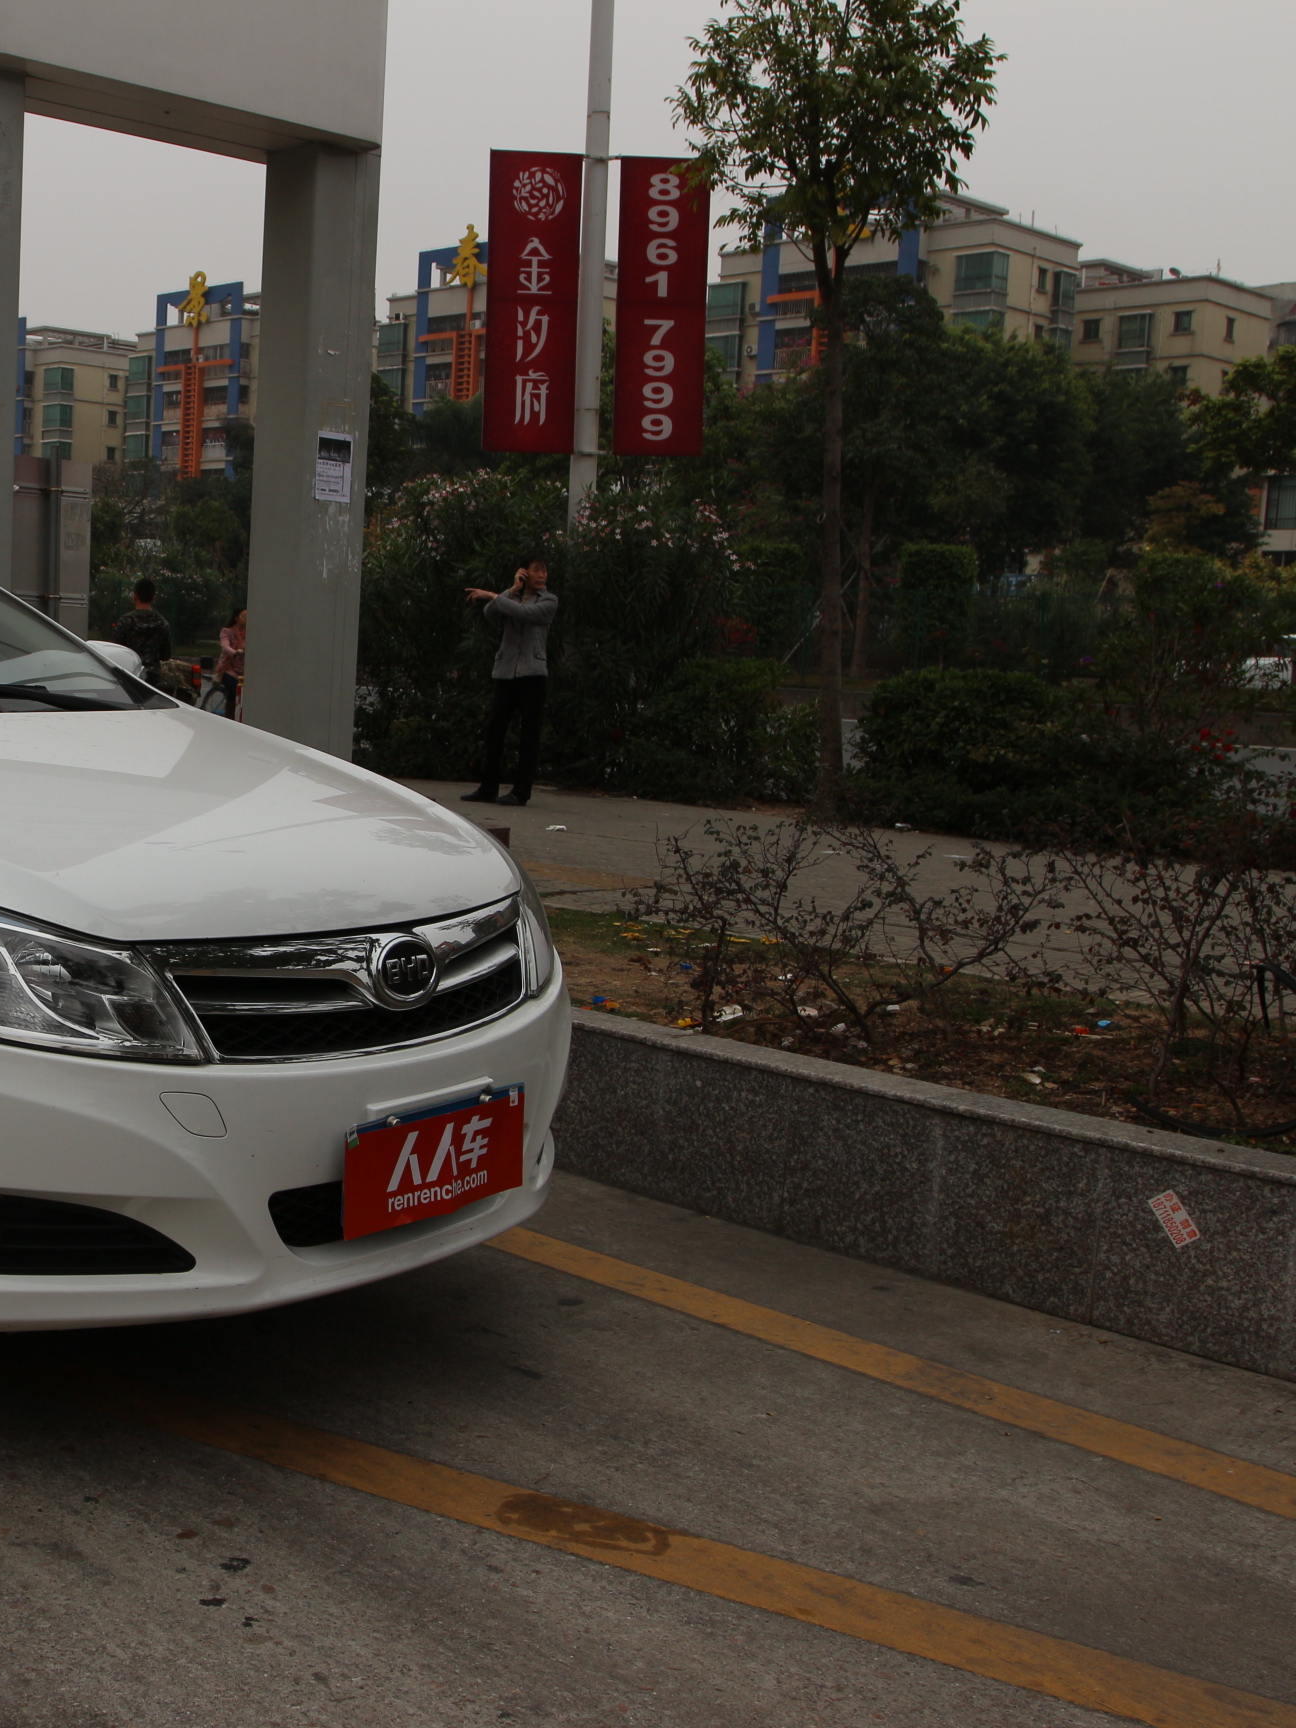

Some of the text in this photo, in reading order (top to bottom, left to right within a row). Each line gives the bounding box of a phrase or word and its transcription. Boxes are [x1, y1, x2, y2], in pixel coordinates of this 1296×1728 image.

[443, 224, 487, 288] 春
[178, 271, 209, 327] 景
[641, 173, 681, 441] 8961 7999
[514, 237, 553, 426] 金汐府
[386, 954, 431, 985] BYD
[386, 1115, 493, 1193] 人人车
[388, 1170, 488, 1212] renrenche.com
[1163, 1192, 1182, 1214] 办证
[1150, 1197, 1187, 1245] 18711850208
